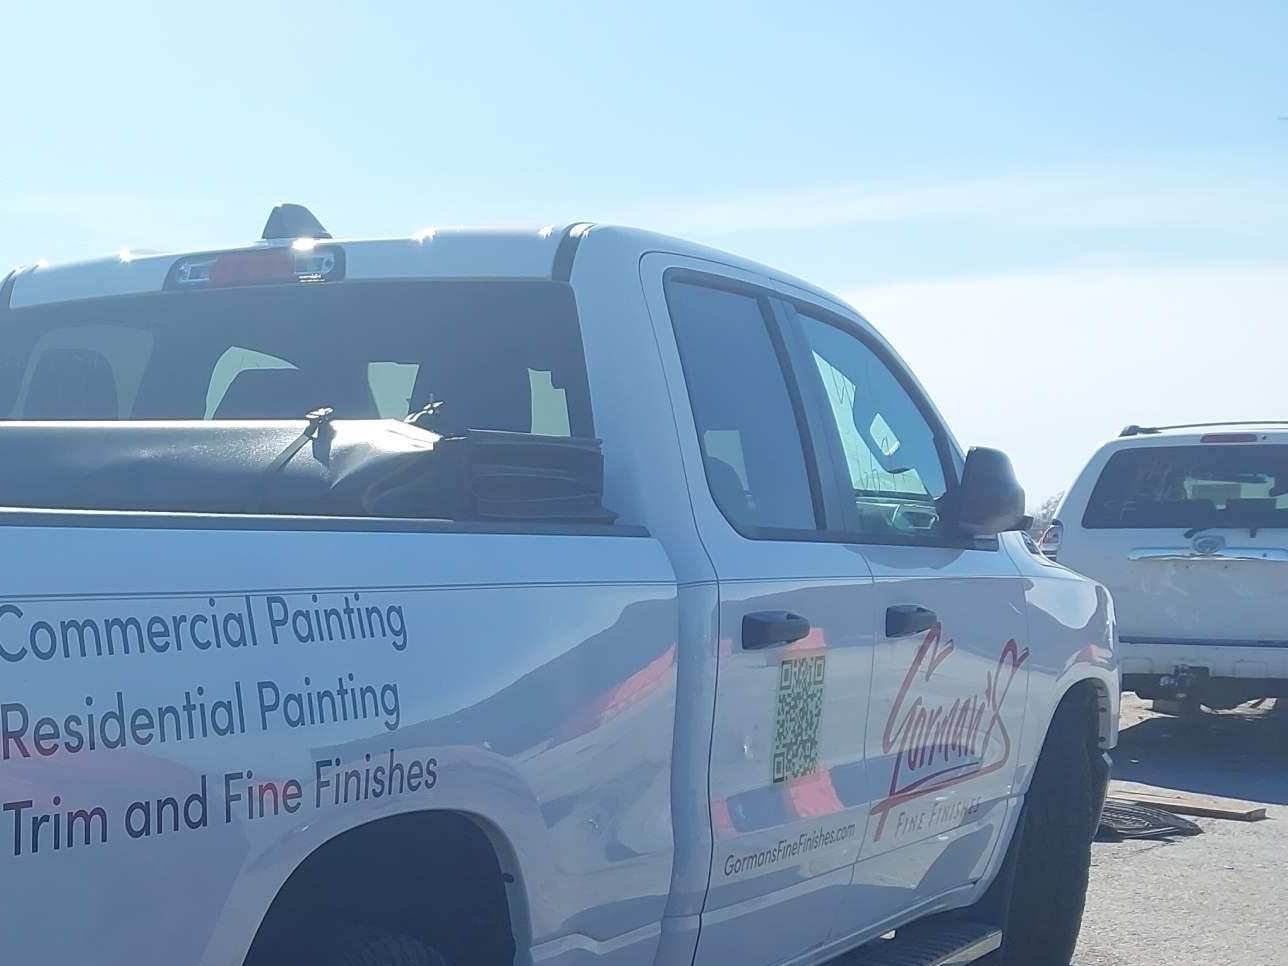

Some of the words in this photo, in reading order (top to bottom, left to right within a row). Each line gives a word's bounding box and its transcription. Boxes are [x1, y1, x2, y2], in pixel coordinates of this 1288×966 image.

[267, 592, 407, 651] Painting
[0, 681, 246, 760] Residential
[257, 672, 401, 731] Painting
[3, 796, 108, 855] Trim
[125, 774, 208, 839] and
[224, 770, 302, 823] Fine
[316, 748, 437, 808] Finishes
[724, 823, 855, 876] GormansFineFinishes.com
